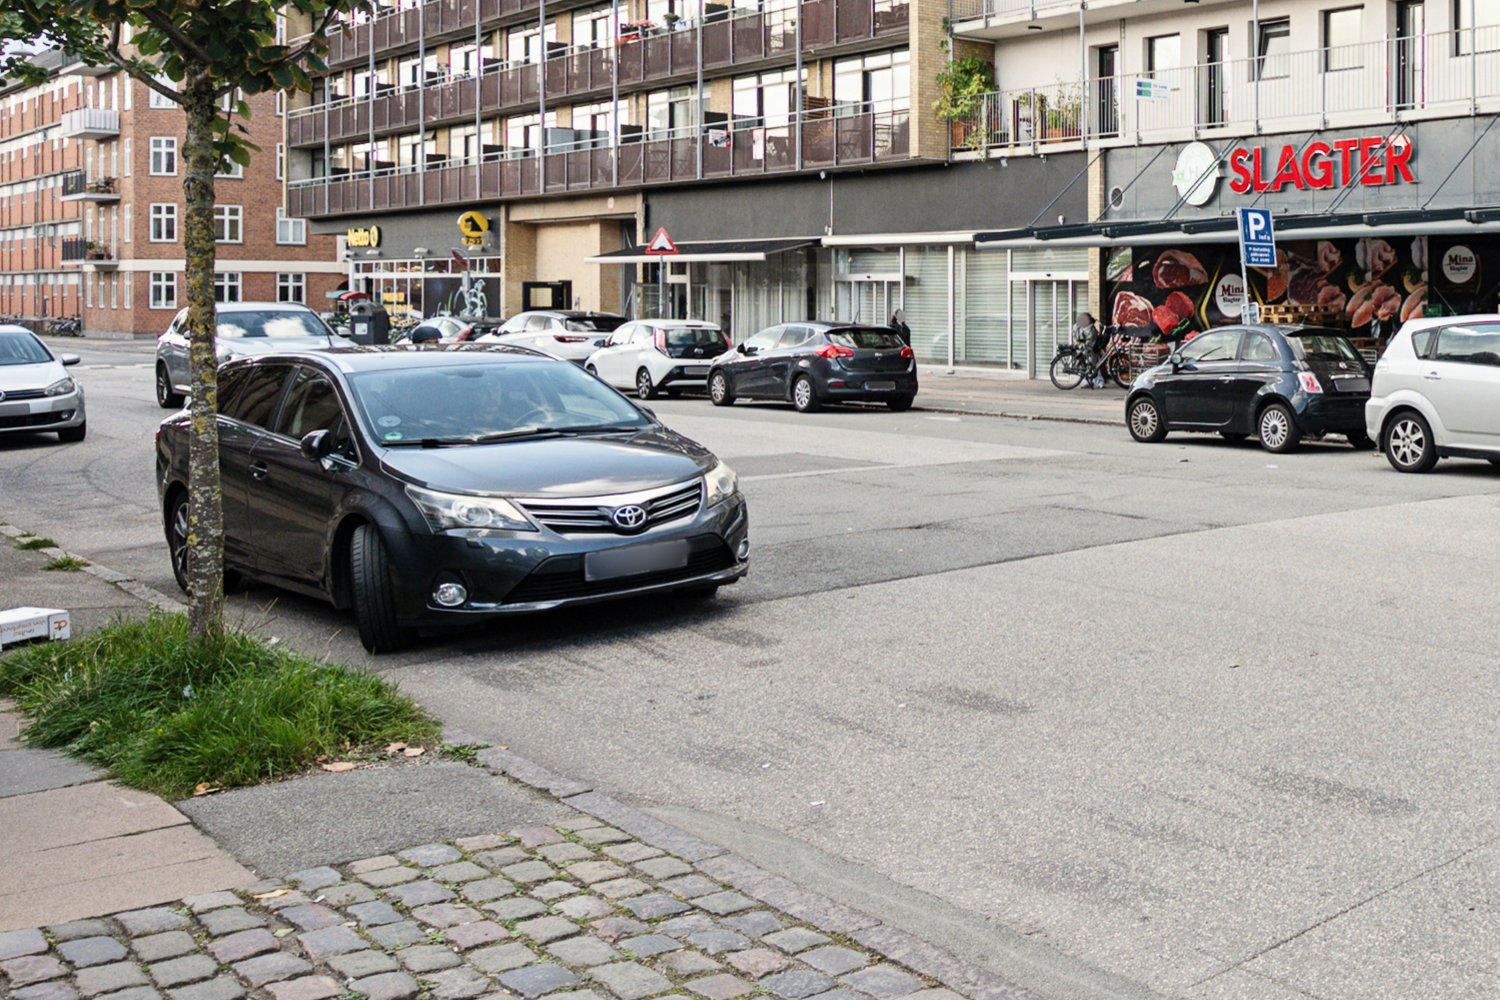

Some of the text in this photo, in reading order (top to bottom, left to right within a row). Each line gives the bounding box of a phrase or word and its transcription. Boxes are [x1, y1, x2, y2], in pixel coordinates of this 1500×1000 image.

[1229, 134, 1415, 194] SLAGTER
[348, 228, 370, 247] Netto
[1248, 212, 1265, 240] P
[1448, 254, 1473, 265] Mina
